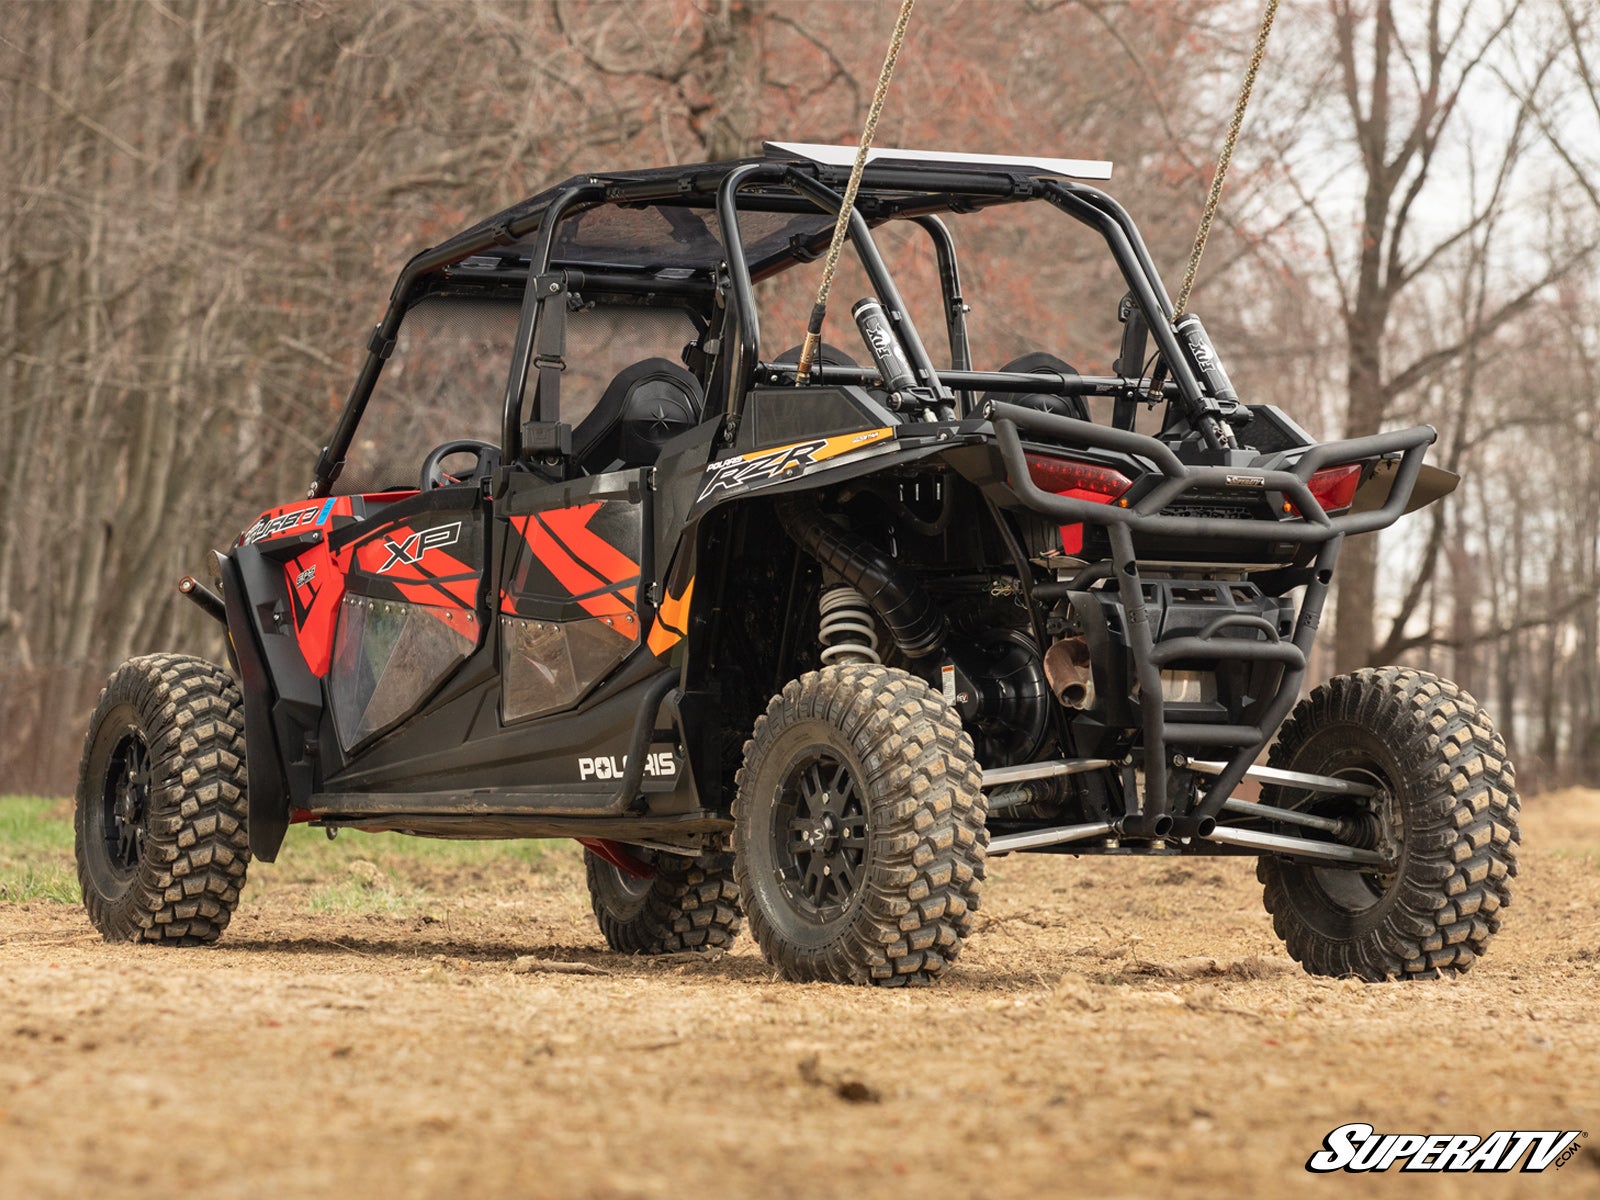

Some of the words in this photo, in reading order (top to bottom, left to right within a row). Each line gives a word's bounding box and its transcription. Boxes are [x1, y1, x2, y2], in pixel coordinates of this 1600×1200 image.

[697, 439, 829, 503] RZR
[706, 456, 743, 472] POLARIS
[376, 521, 462, 574] XP
[578, 752, 676, 780] POLRIS
